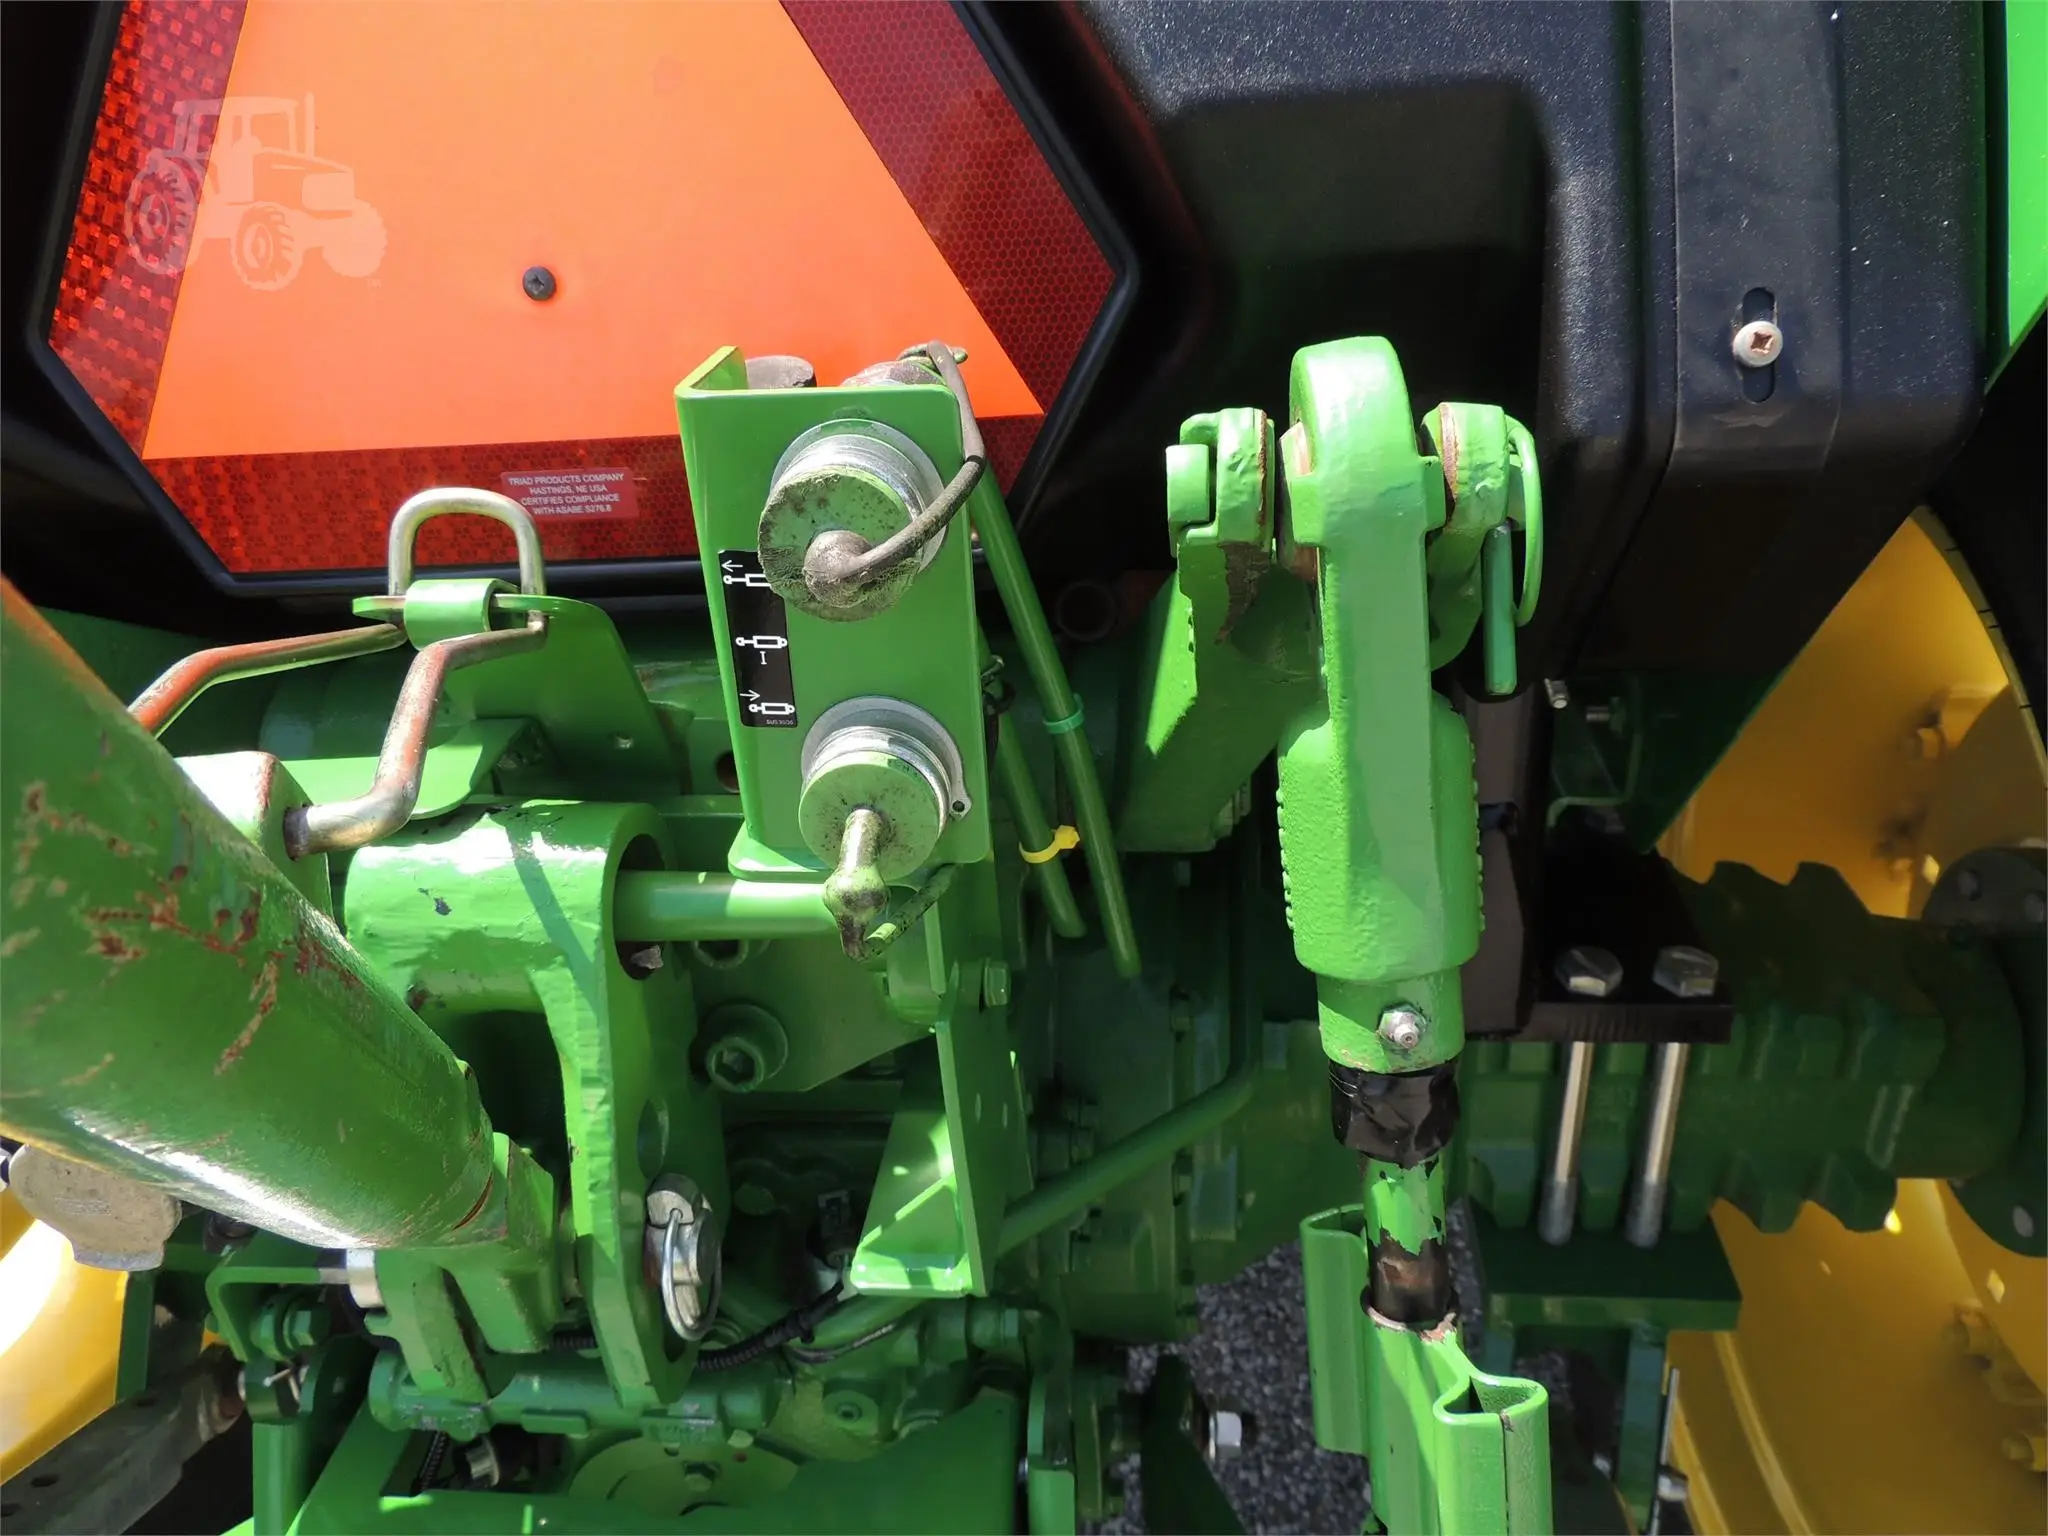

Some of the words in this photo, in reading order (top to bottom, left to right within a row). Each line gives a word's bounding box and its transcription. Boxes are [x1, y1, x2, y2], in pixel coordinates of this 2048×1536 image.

[508, 477, 533, 485] TRIAD
[534, 475, 581, 484] PRODUCTS
[582, 473, 624, 482] COMPANY
[575, 485, 588, 493] NE
[590, 484, 608, 492] USA
[521, 496, 564, 505] CERTIFIES
[565, 494, 619, 503] COMPLIANCE
[532, 507, 556, 515] WITH
[556, 505, 584, 514] ASABE
